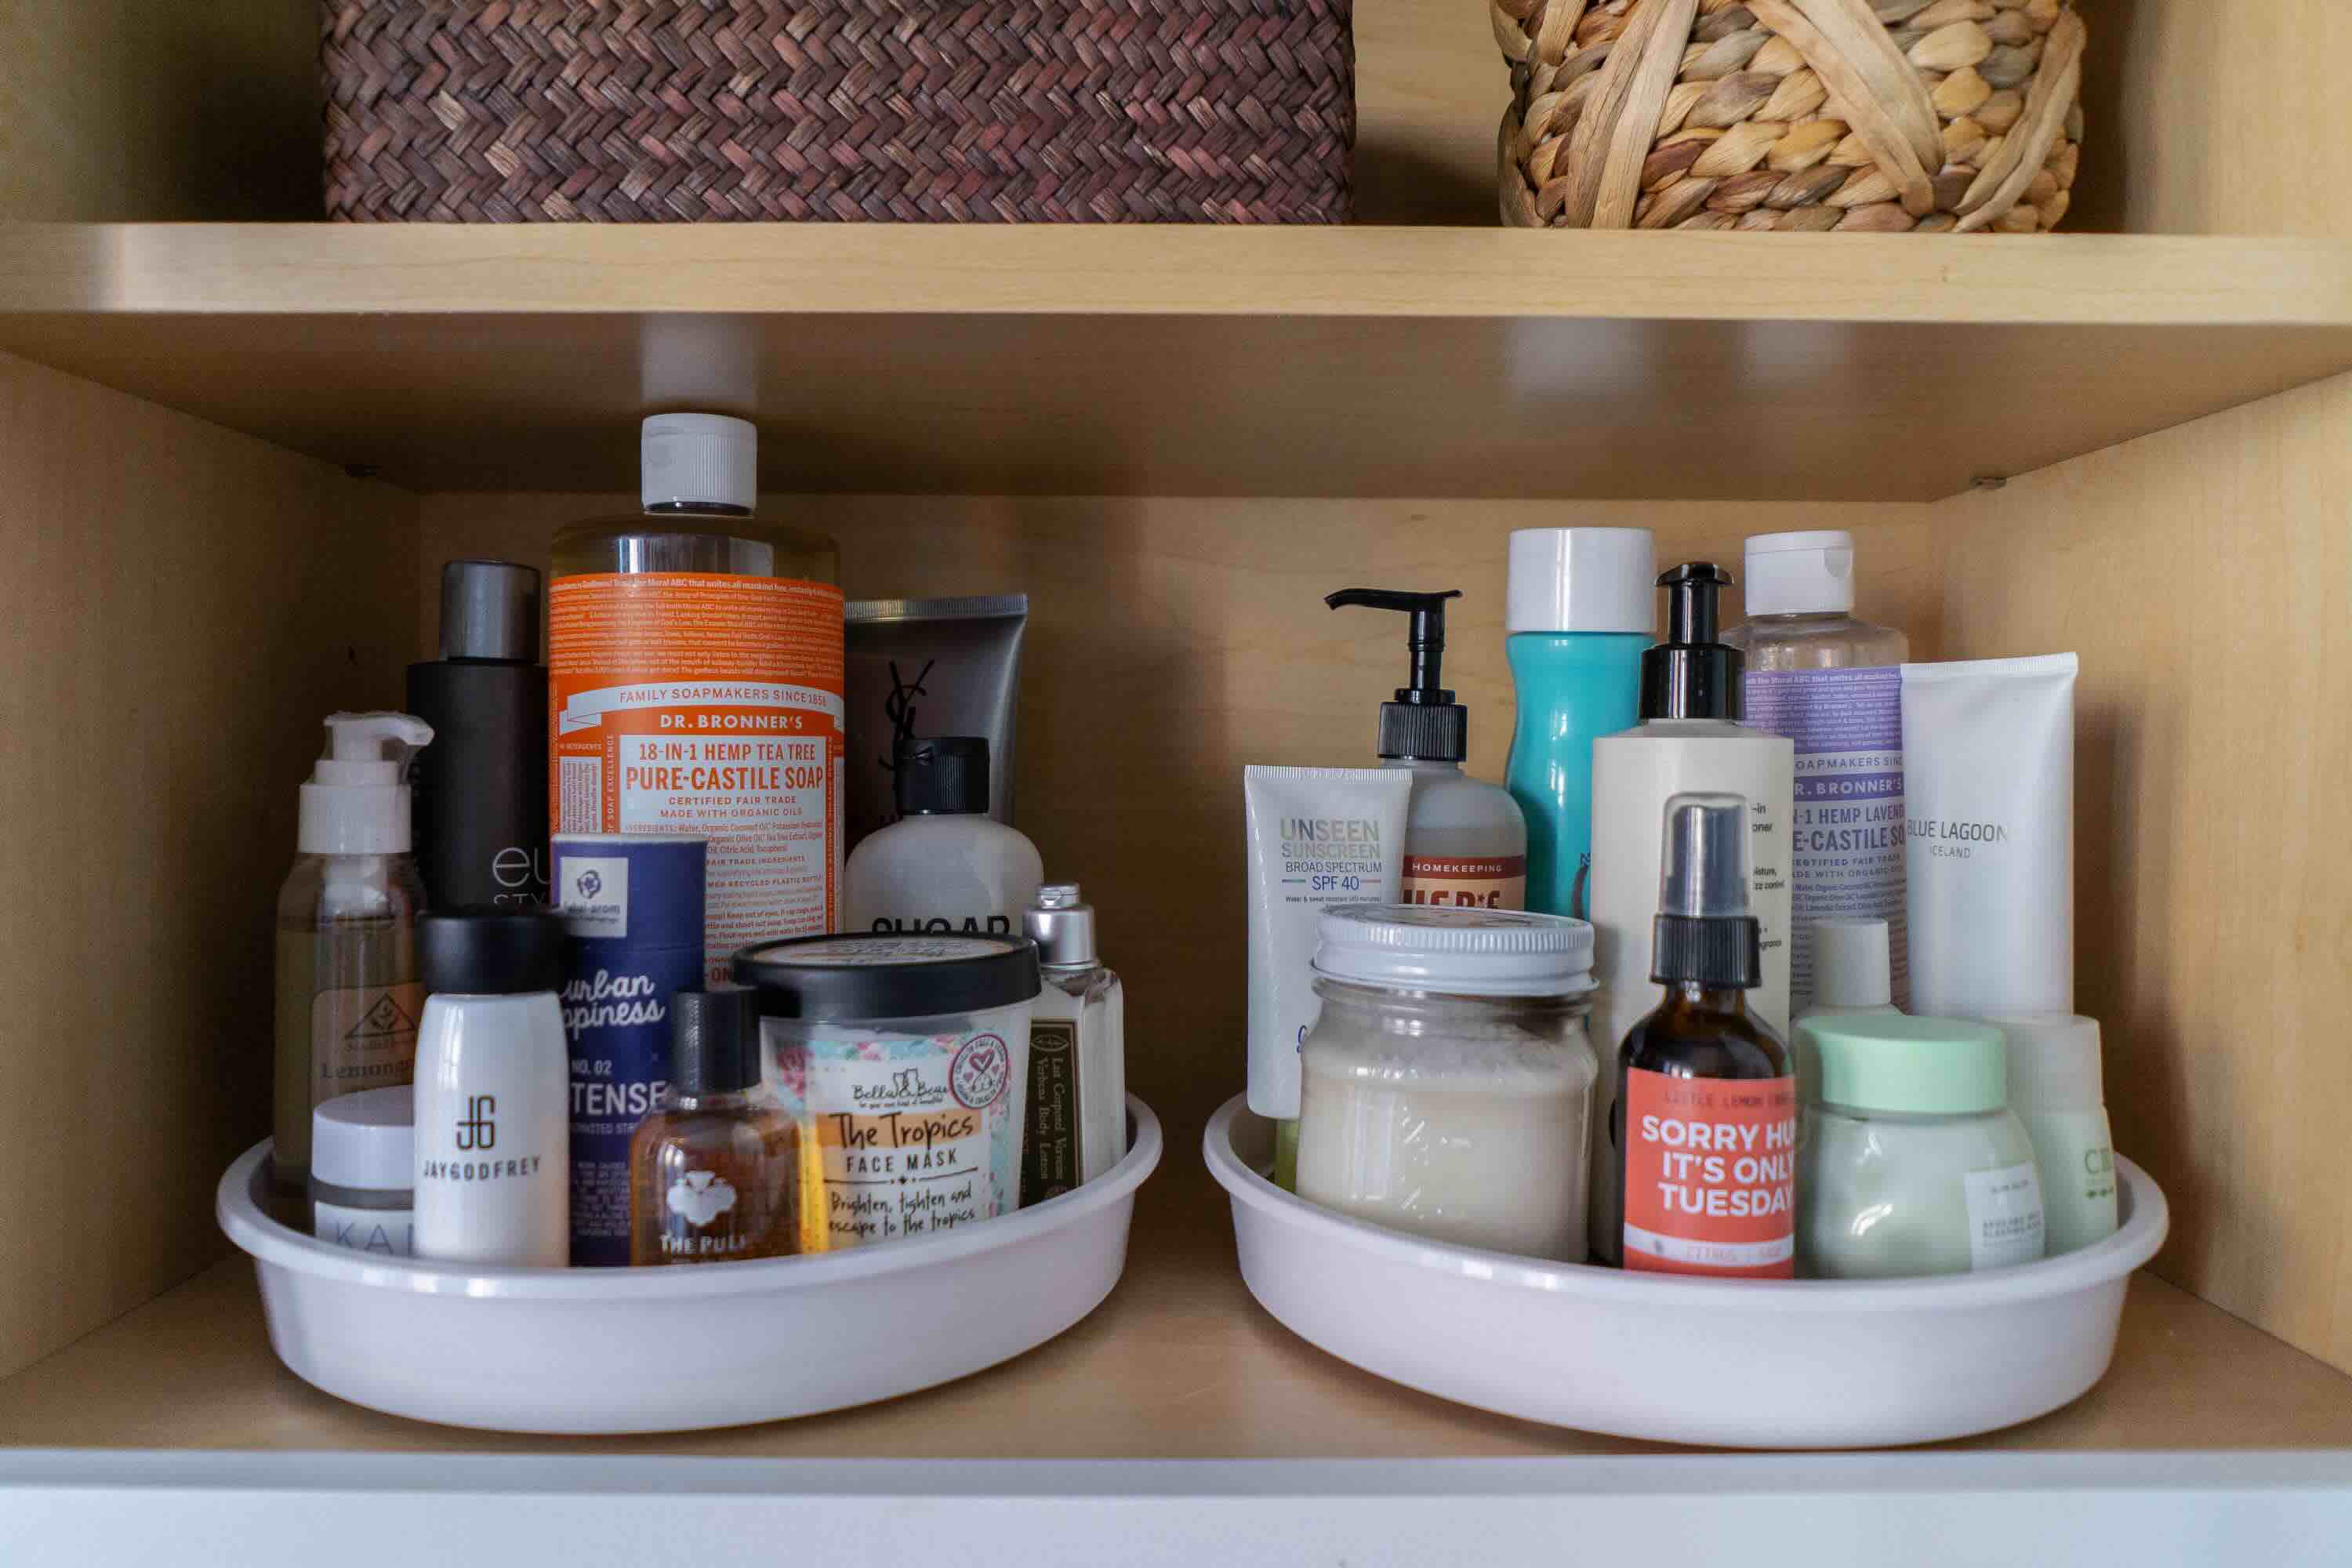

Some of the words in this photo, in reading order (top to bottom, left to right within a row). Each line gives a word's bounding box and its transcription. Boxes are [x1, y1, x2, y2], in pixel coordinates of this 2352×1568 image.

[619, 690, 667, 703] FAMILY
[672, 688, 769, 701] SOAPMAKERS
[772, 690, 807, 703] SINCE
[660, 714, 693, 728] DR.
[698, 714, 803, 729] BRONNER'S
[639, 742, 697, 761] 18-IN-1
[705, 742, 751, 761] HEMP
[757, 743, 783, 761] TEA
[788, 743, 816, 761] TREE
[1794, 757, 1882, 770] OAPMAKERS
[626, 766, 781, 790] PURE-CASTILE
[785, 765, 823, 790] SOAP
[1794, 782, 1813, 796] R.
[1816, 777, 1902, 795] BRONNER'S
[669, 796, 731, 805] CERTIFIED
[736, 796, 761, 804] FAIR
[765, 795, 797, 804] TRADE
[659, 809, 693, 818] MADE
[697, 809, 728, 818] WITH
[731, 808, 779, 817] ORGANIC
[782, 807, 803, 817] OILS
[1819, 808, 1861, 824] HEMP
[1866, 803, 1904, 822] LAVEND
[1279, 818, 1380, 841] UNSEEN
[1793, 827, 1889, 853] E-CASTILE
[1907, 821, 1936, 838] BLUE
[1940, 821, 2008, 842] LAGOON
[1281, 842, 1381, 859] SUNSCREEN
[1286, 861, 1323, 873] BROAD
[1325, 861, 1382, 873] SPECTRUM
[1411, 862, 1503, 873] HOMEKEEPING
[1793, 858, 1849, 866] ERTIFIED
[1312, 875, 1338, 891] SPF
[1341, 875, 1360, 891] 40
[561, 969, 655, 1001] urban
[564, 999, 666, 1040] ppiness
[593, 1059, 612, 1074] 02
[828, 1112, 878, 1150] The
[879, 1111, 974, 1150] Tropics
[1642, 1114, 1759, 1152] SORRY
[423, 1156, 541, 1181] JAYGODFREY
[846, 1154, 895, 1174] FACE
[906, 1148, 958, 1171] MASK
[1662, 1151, 1727, 1184] IT'S
[831, 1191, 892, 1215] Brighten,
[898, 1189, 946, 1215] tighten
[950, 1180, 972, 1204] and
[828, 1220, 876, 1239] escape
[883, 1215, 897, 1236] to
[903, 1214, 924, 1236] the
[931, 1208, 975, 1231] tropics
[659, 1234, 697, 1255] THE
